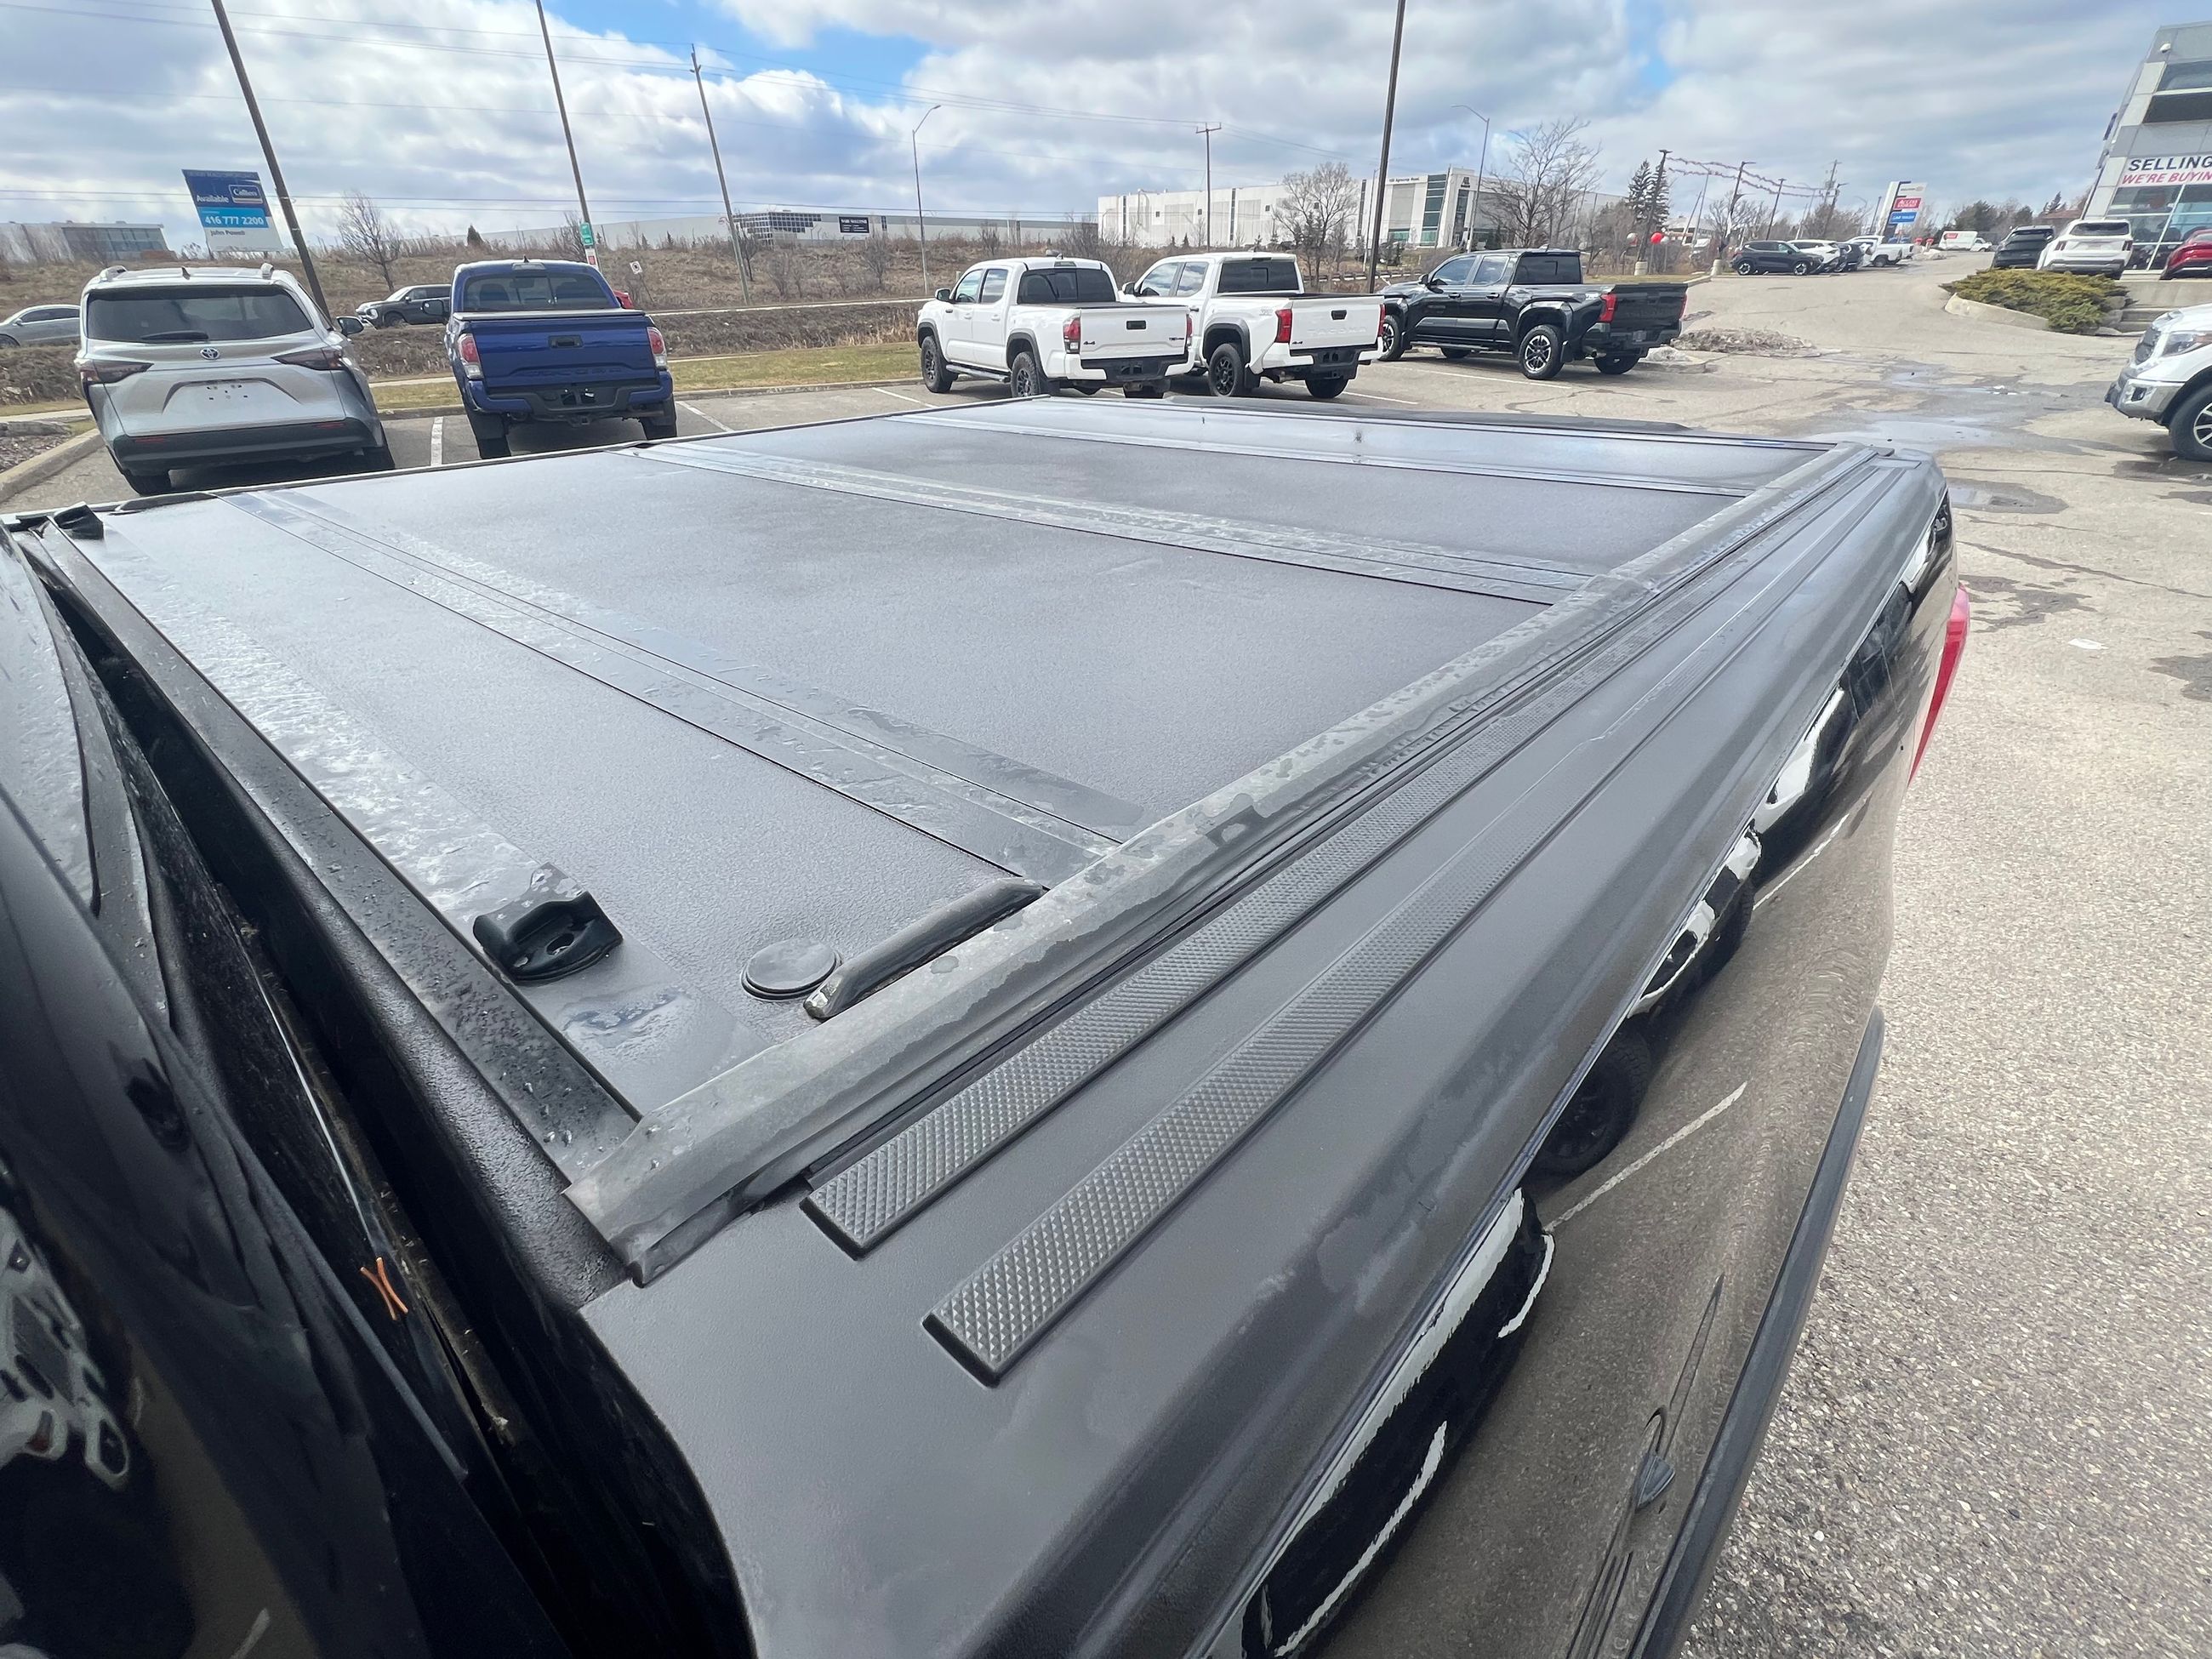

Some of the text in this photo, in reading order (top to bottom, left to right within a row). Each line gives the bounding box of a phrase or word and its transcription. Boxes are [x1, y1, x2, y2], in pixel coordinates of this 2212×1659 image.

[2129, 157, 2212, 171] SELLING
[2122, 173, 2168, 184] WE'RE
[197, 195, 230, 203] Available
[205, 215, 264, 225] 416 777 2200
